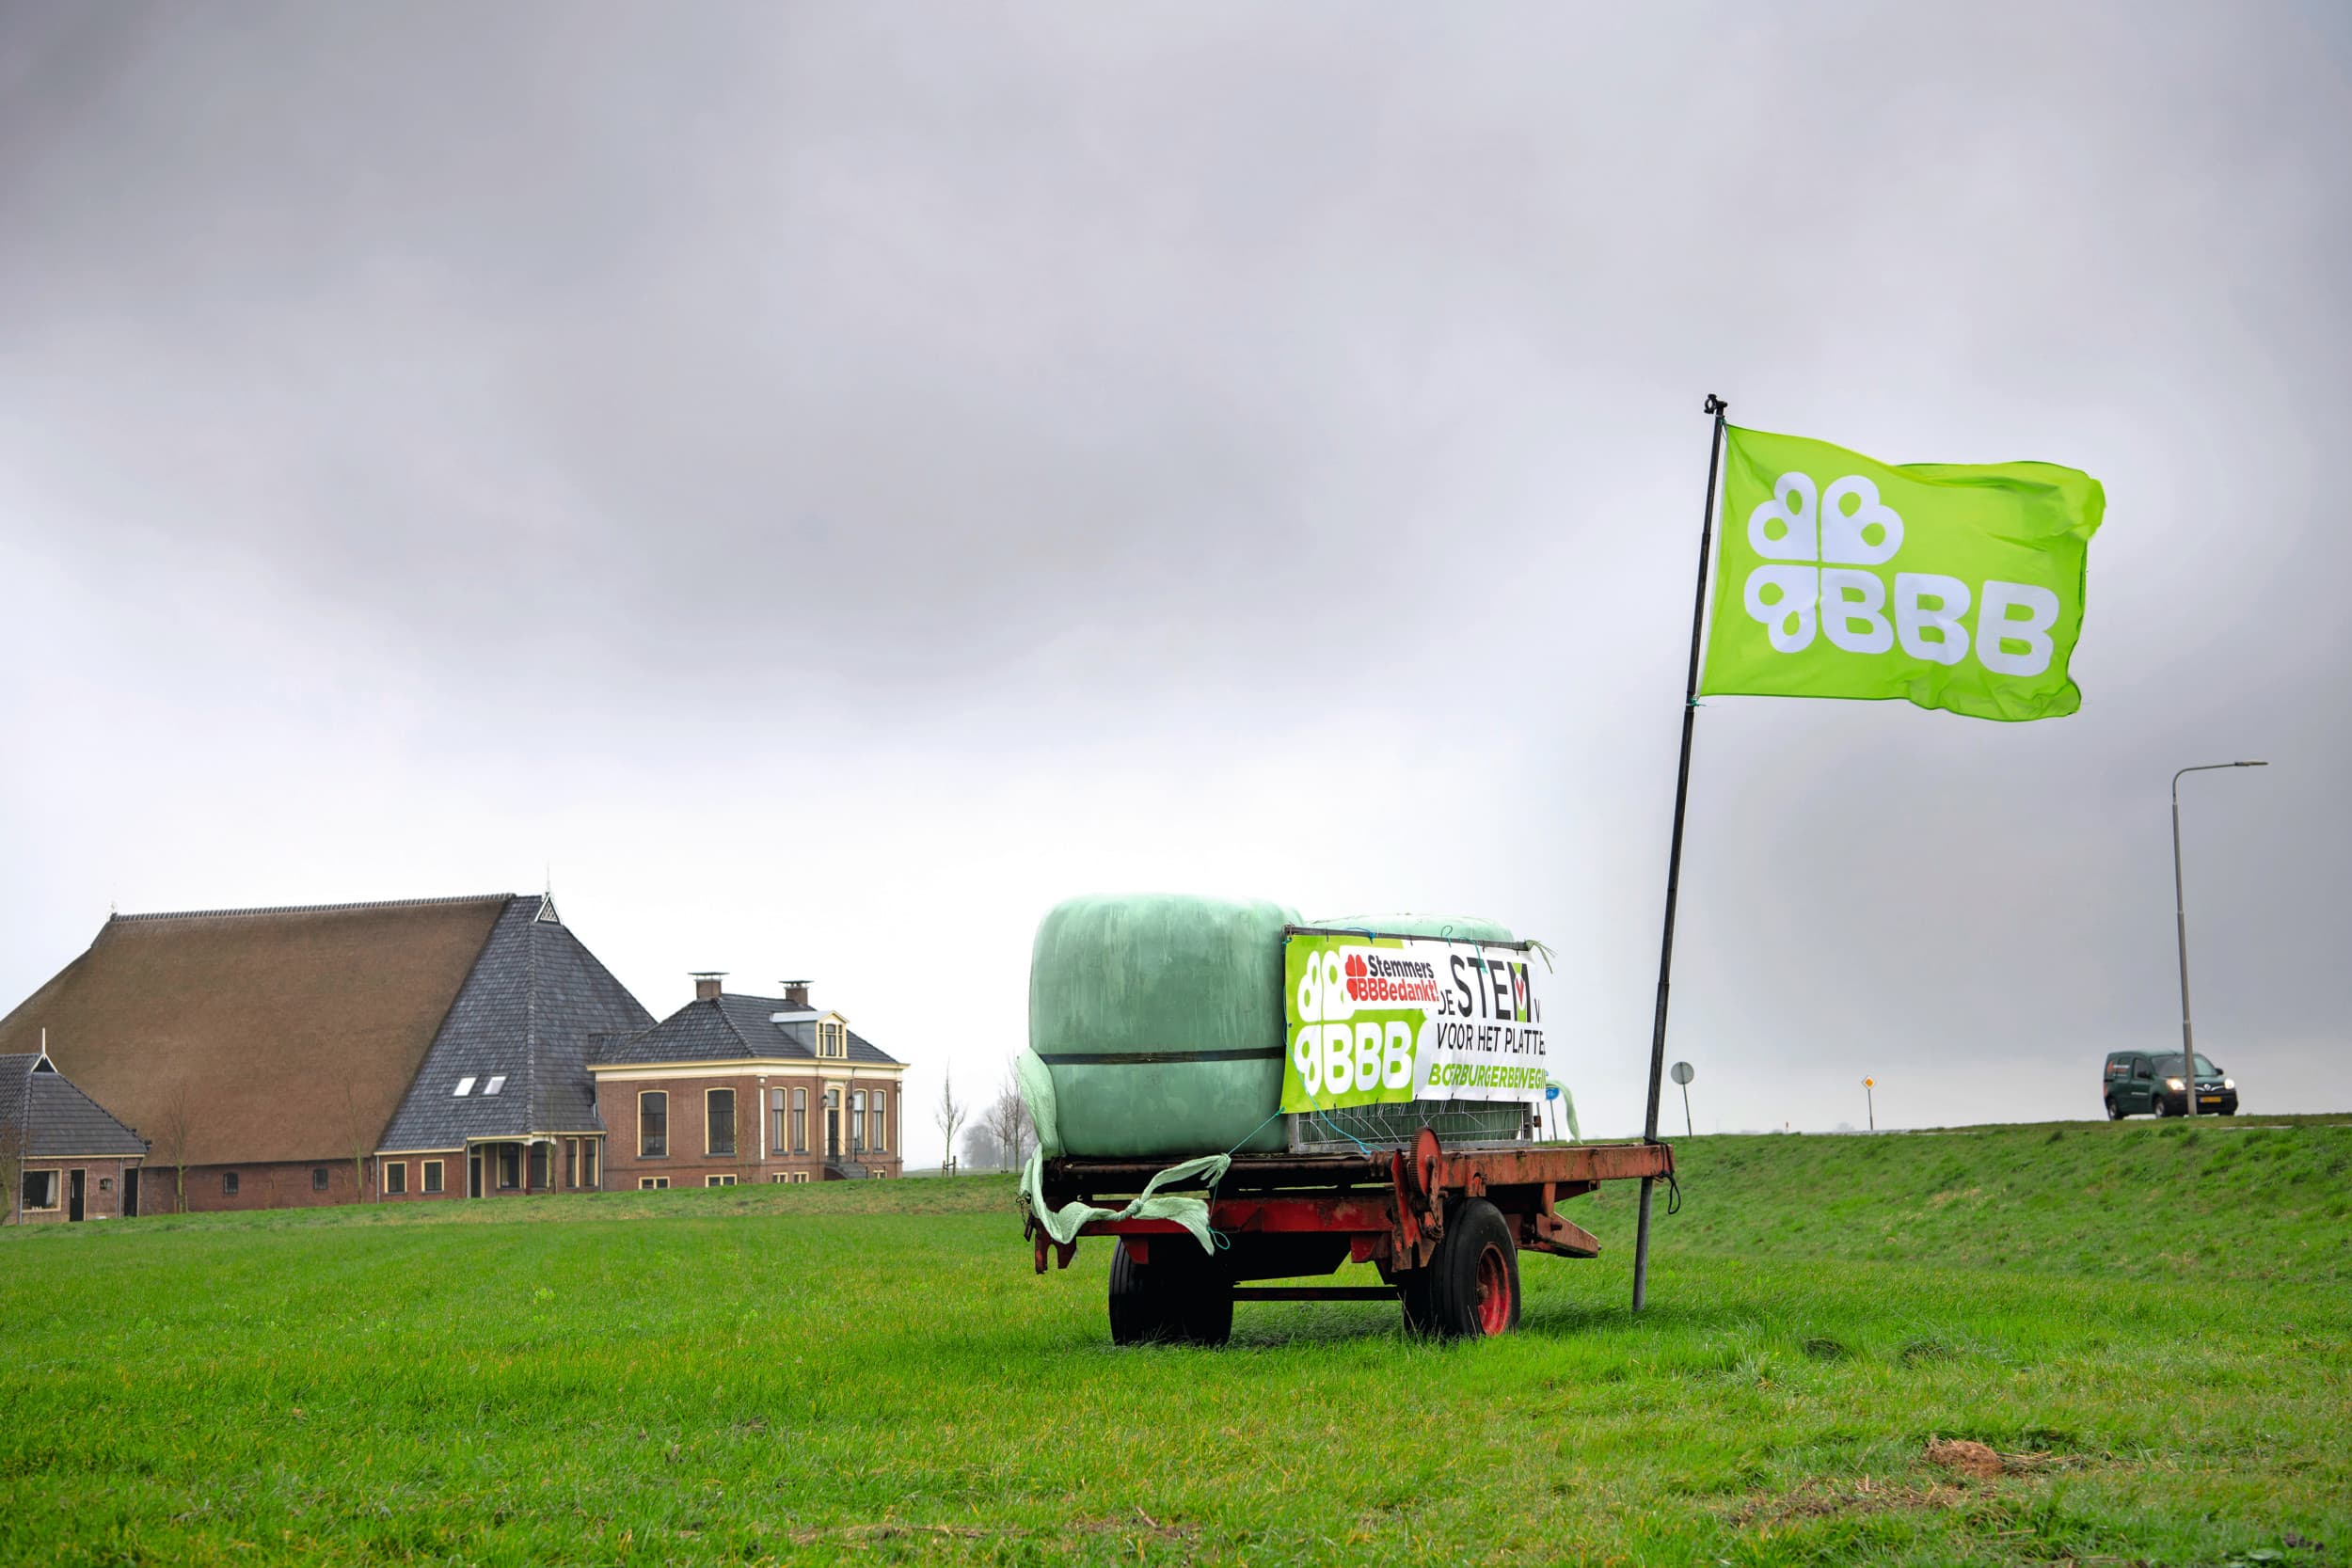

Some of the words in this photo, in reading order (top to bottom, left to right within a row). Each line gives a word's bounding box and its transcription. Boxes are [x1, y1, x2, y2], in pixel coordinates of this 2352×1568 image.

[1820, 567, 2060, 677] BBB
[1358, 978, 1439, 1002] BBBedankt!
[1368, 955, 1434, 978] Stemmers
[1438, 990, 1455, 1016] JE
[1450, 954, 1532, 1023] STEM
[1323, 1021, 1412, 1094] BBB
[1437, 1022, 1474, 1051] VOOR
[1478, 1024, 1502, 1053] HET
